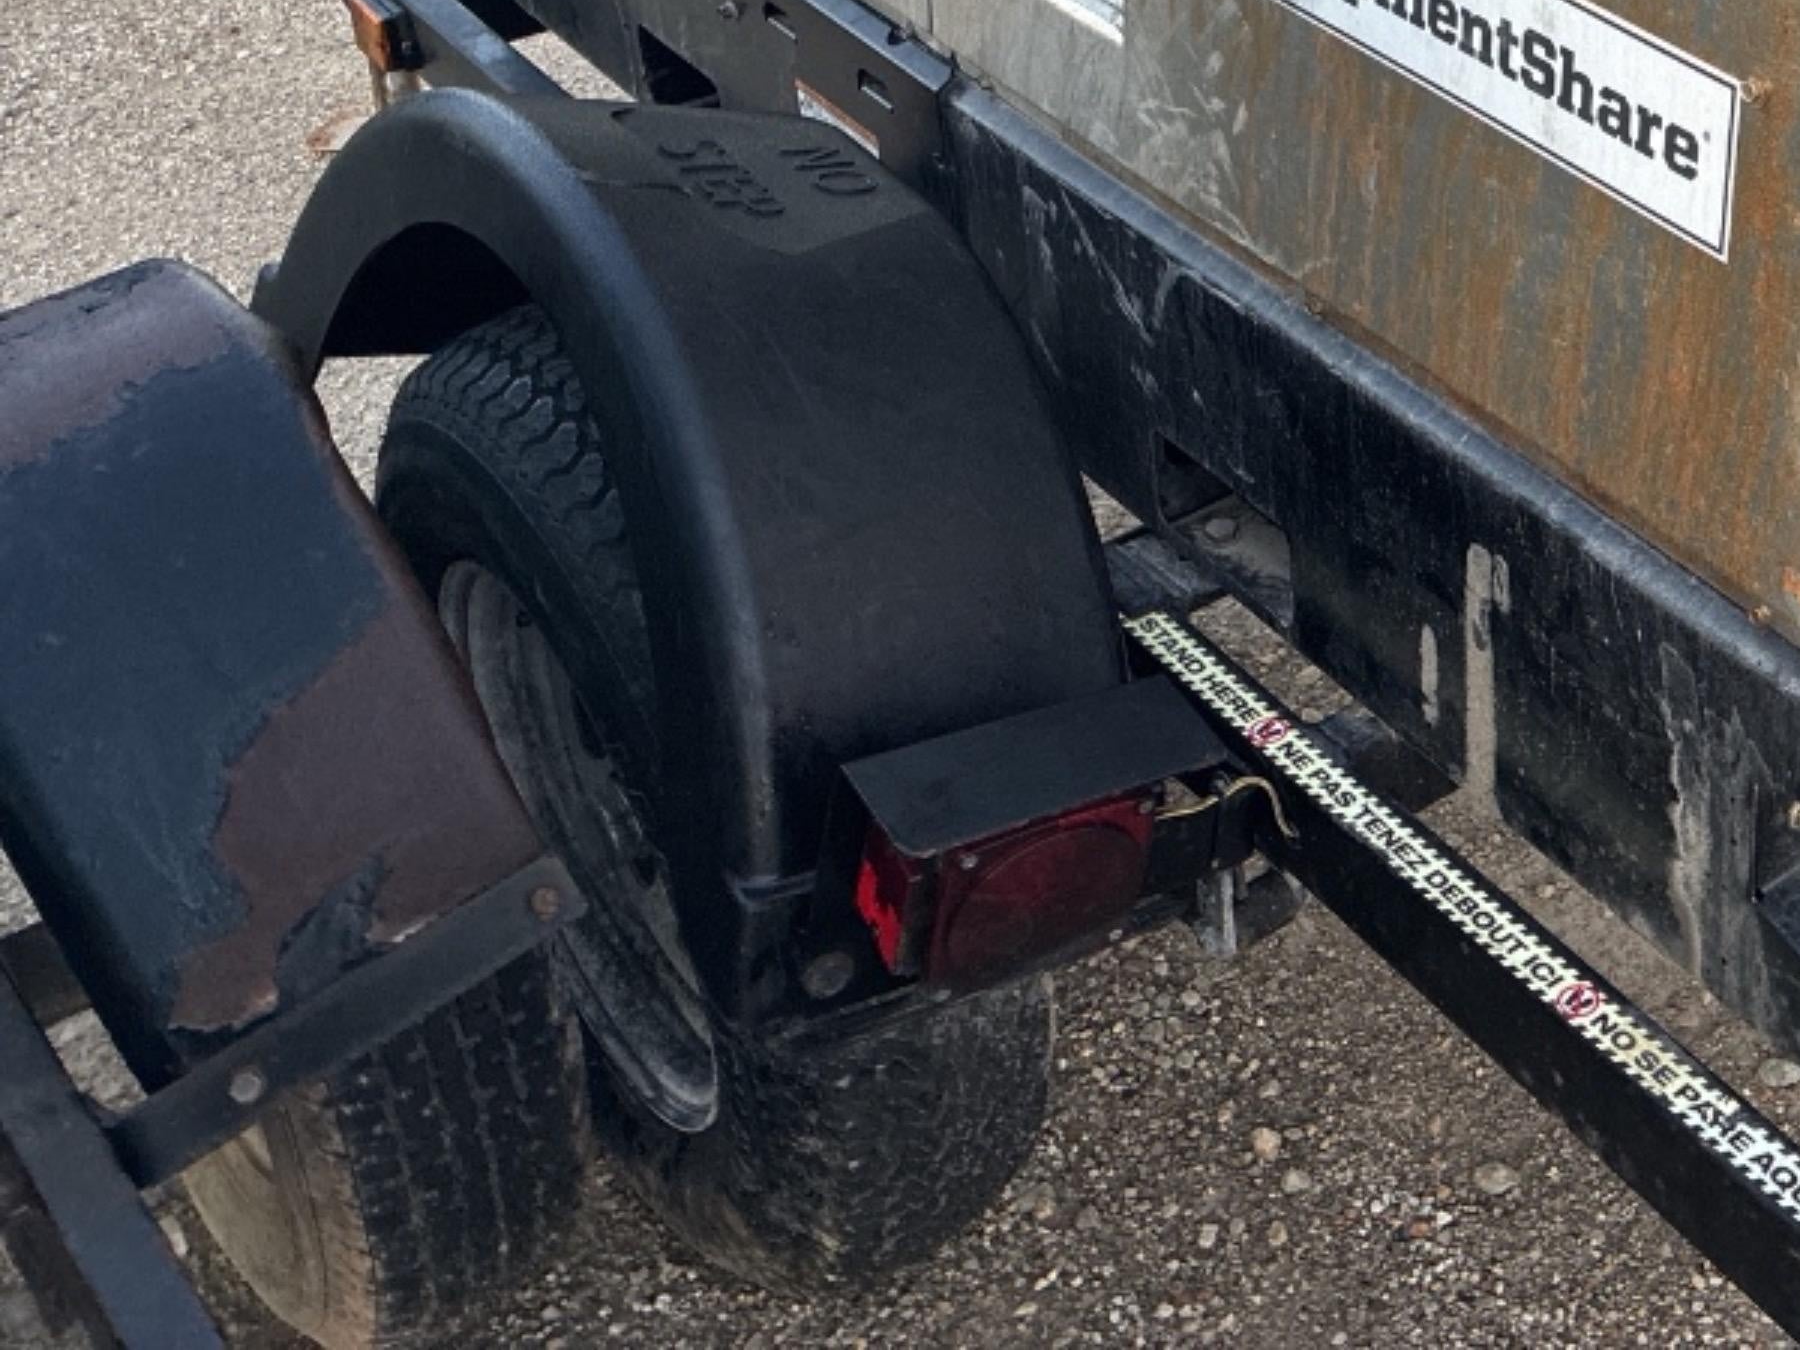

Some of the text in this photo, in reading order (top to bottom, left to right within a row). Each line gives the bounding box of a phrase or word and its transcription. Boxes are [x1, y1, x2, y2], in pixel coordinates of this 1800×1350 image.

[1139, 617, 1258, 722] STAND HERE
[1278, 743, 1564, 990] NE PAS TENEZ DEBOUT ICI
[1590, 1013, 1636, 1050] NO
[1633, 1052, 1679, 1088] SE
[1673, 1085, 1756, 1152] PARE
